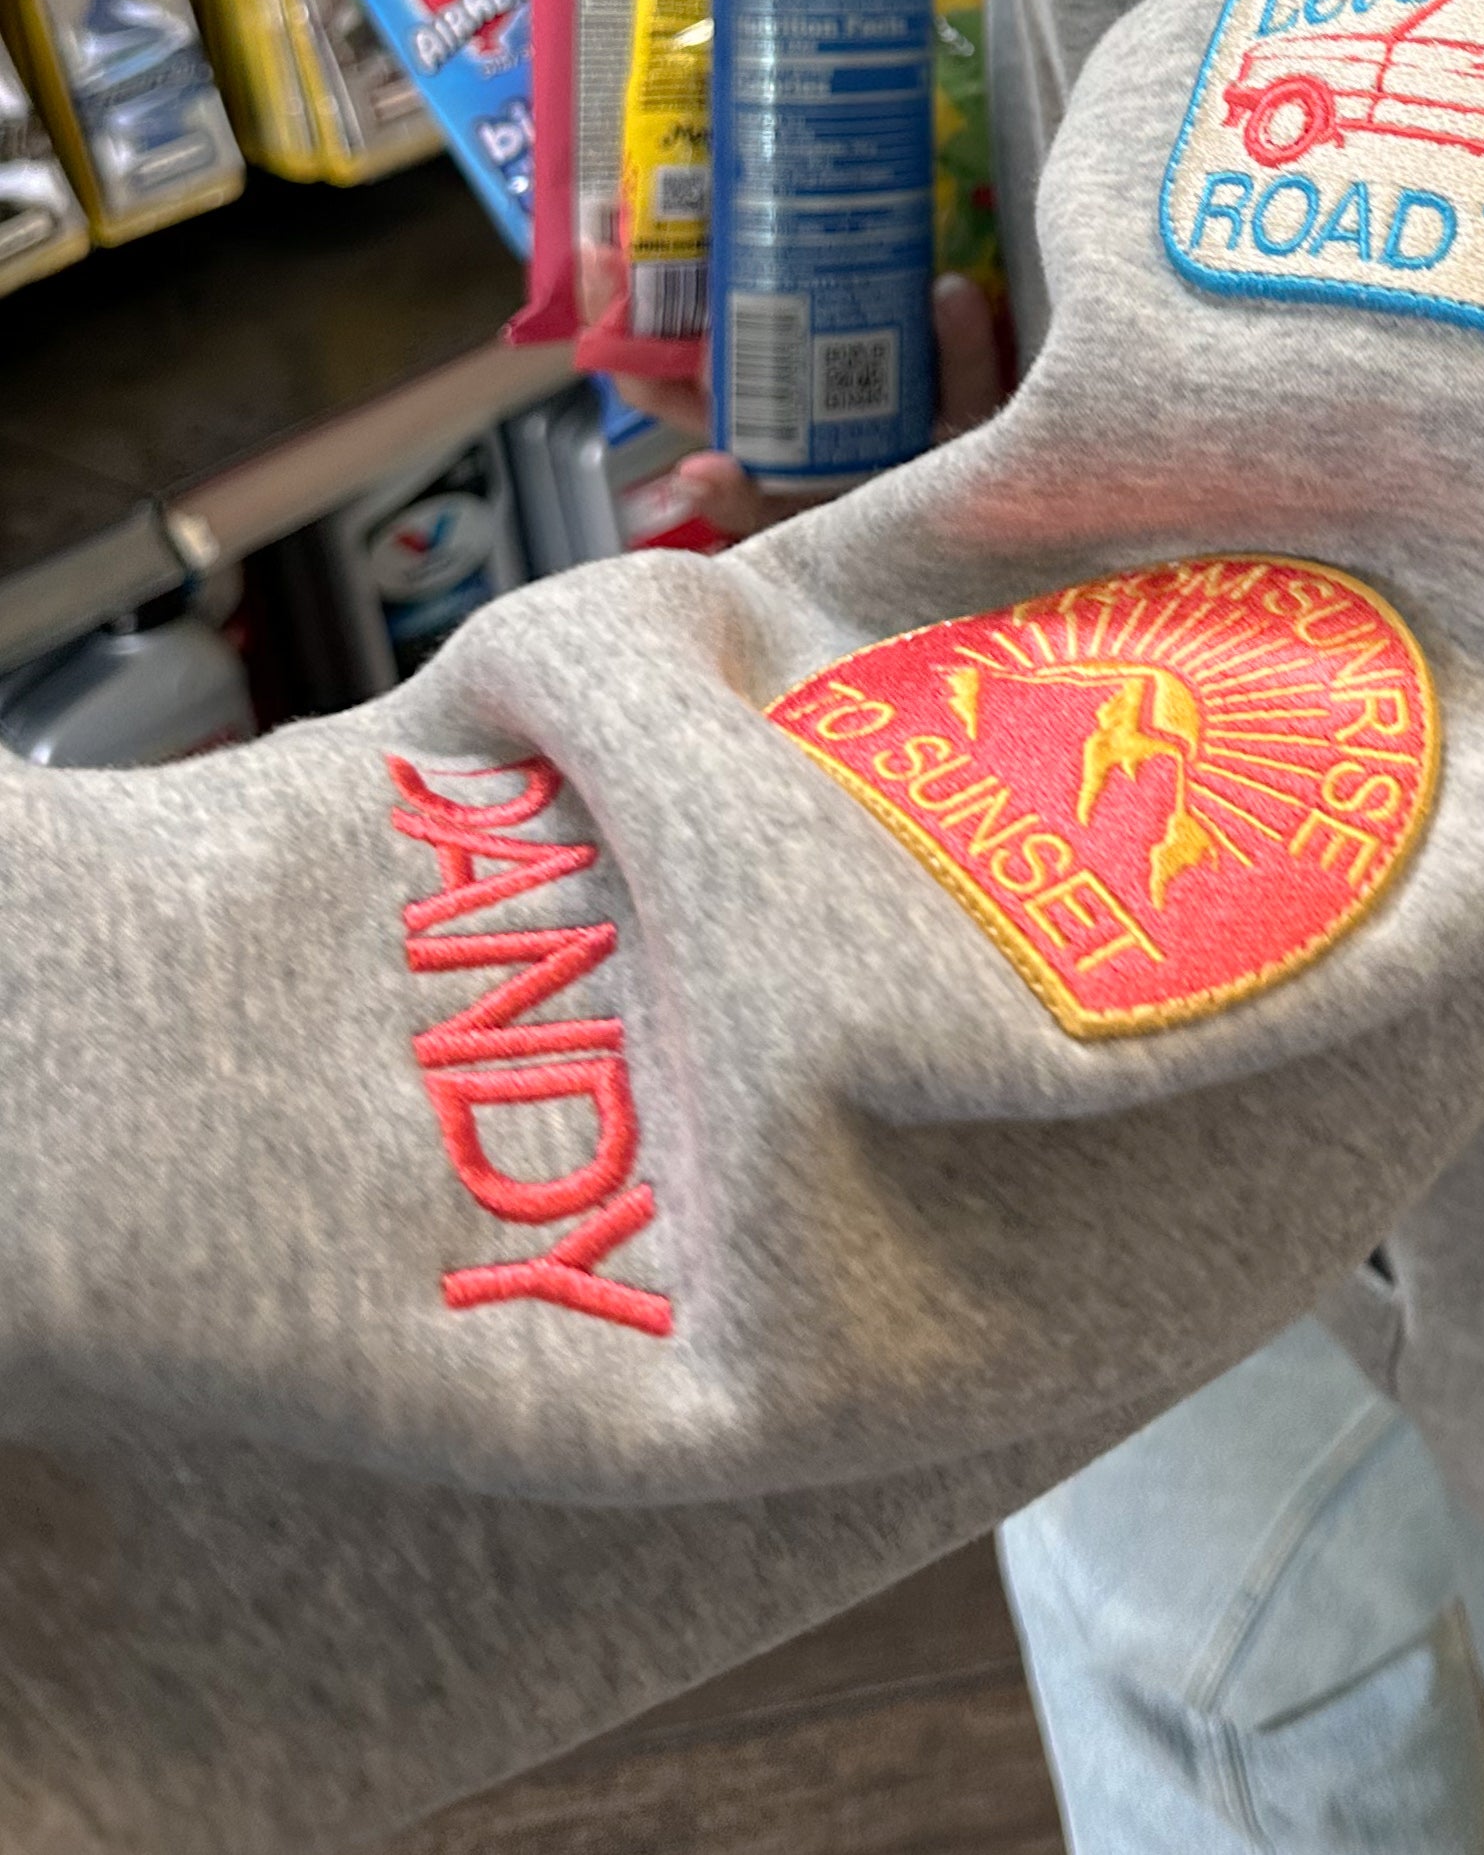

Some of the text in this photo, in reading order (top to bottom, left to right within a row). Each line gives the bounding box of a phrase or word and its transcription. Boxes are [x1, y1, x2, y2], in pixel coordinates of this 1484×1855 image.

[1189, 170, 1458, 270] ROAD
[784, 680, 1166, 973] TO SUNSET
[1263, 576, 1420, 886] SUNRISE
